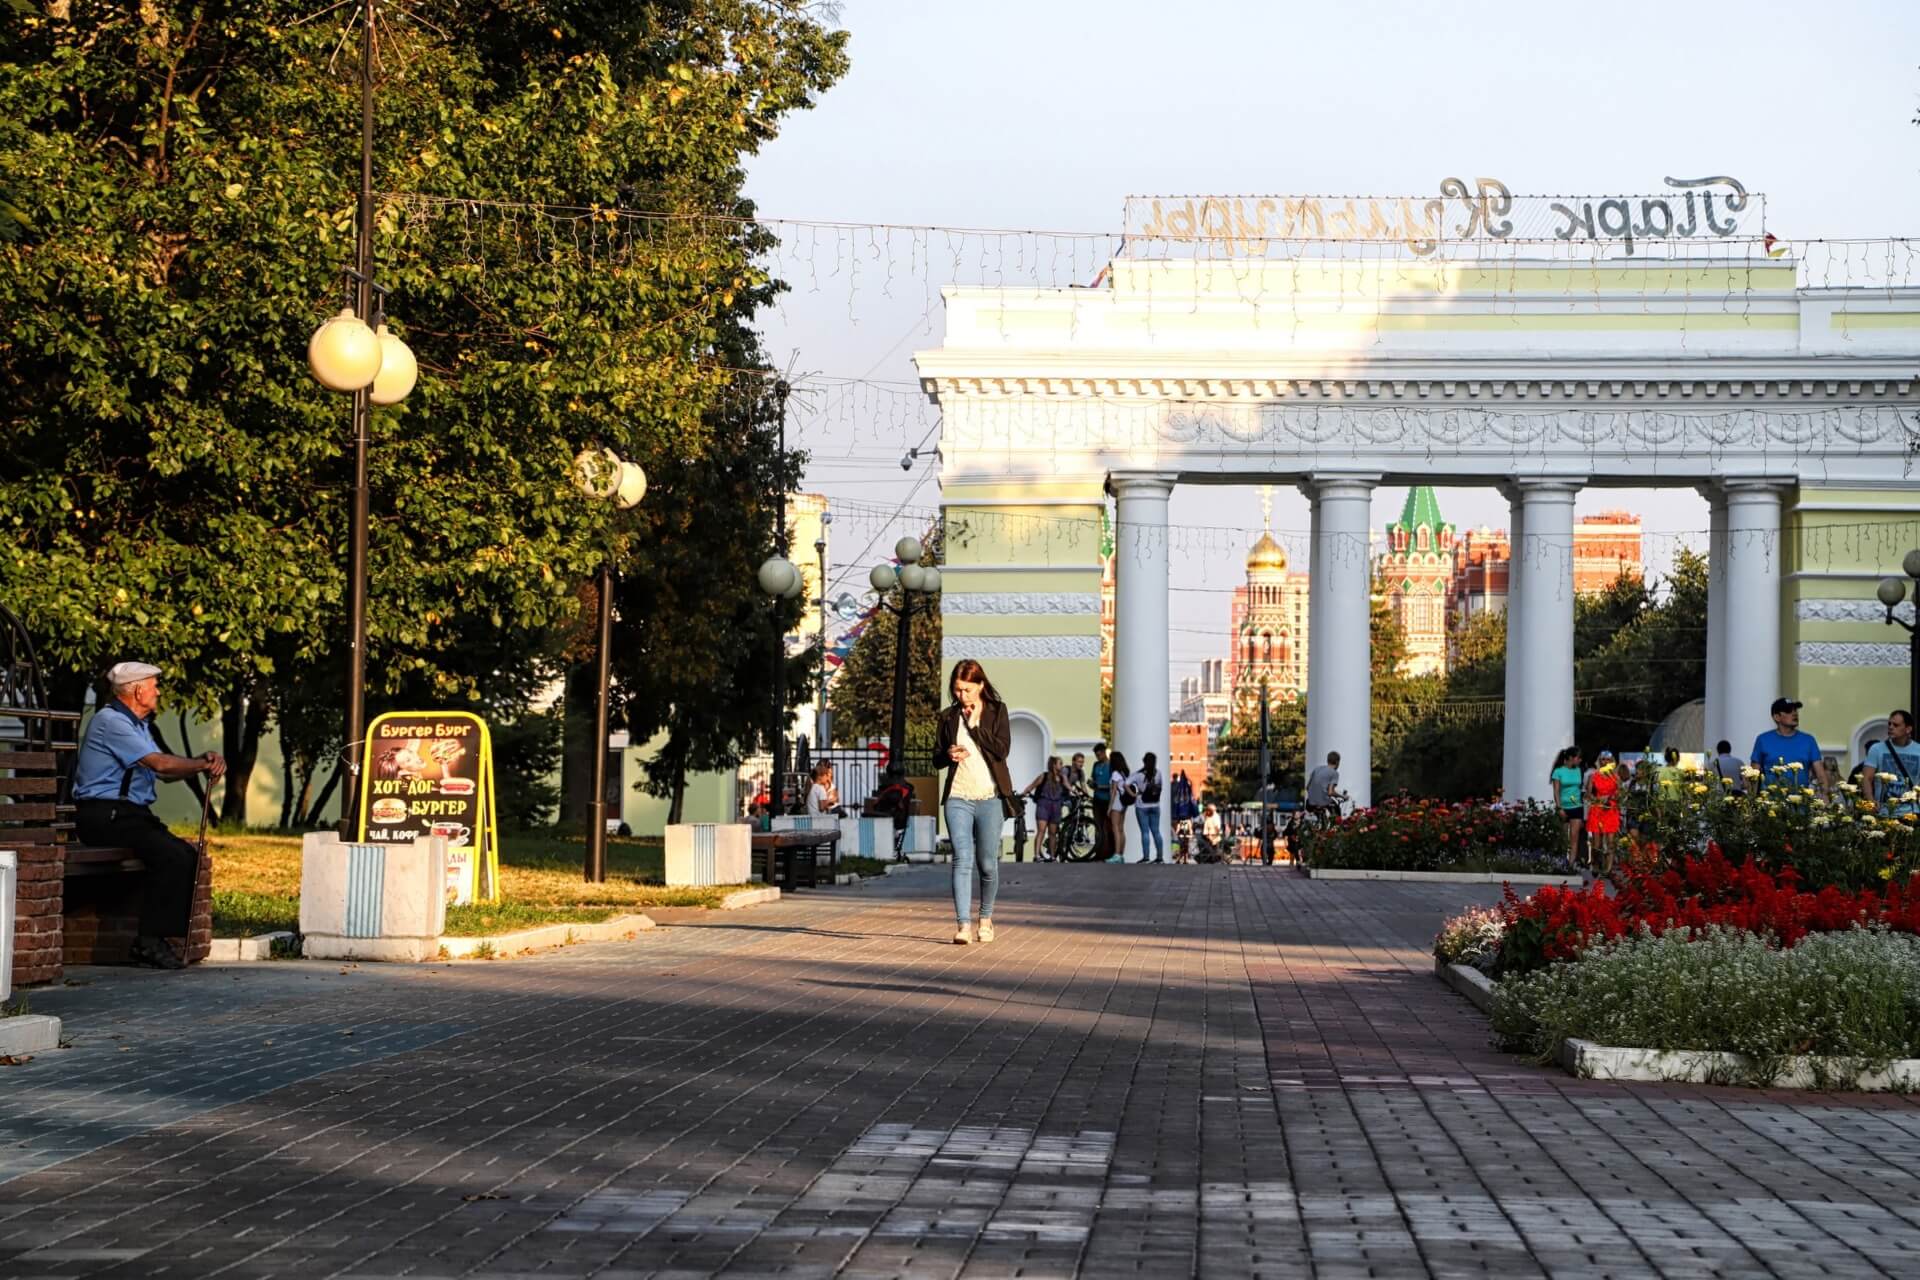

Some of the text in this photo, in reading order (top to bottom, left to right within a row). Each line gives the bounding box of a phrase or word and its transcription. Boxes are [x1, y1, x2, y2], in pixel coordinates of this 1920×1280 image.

[380, 723, 472, 737] Бургер Бург
[373, 780, 435, 795] ХОТ-ДОГ
[411, 800, 468, 815] БУРГЕР
[369, 828, 390, 840] ЧАЙ,
